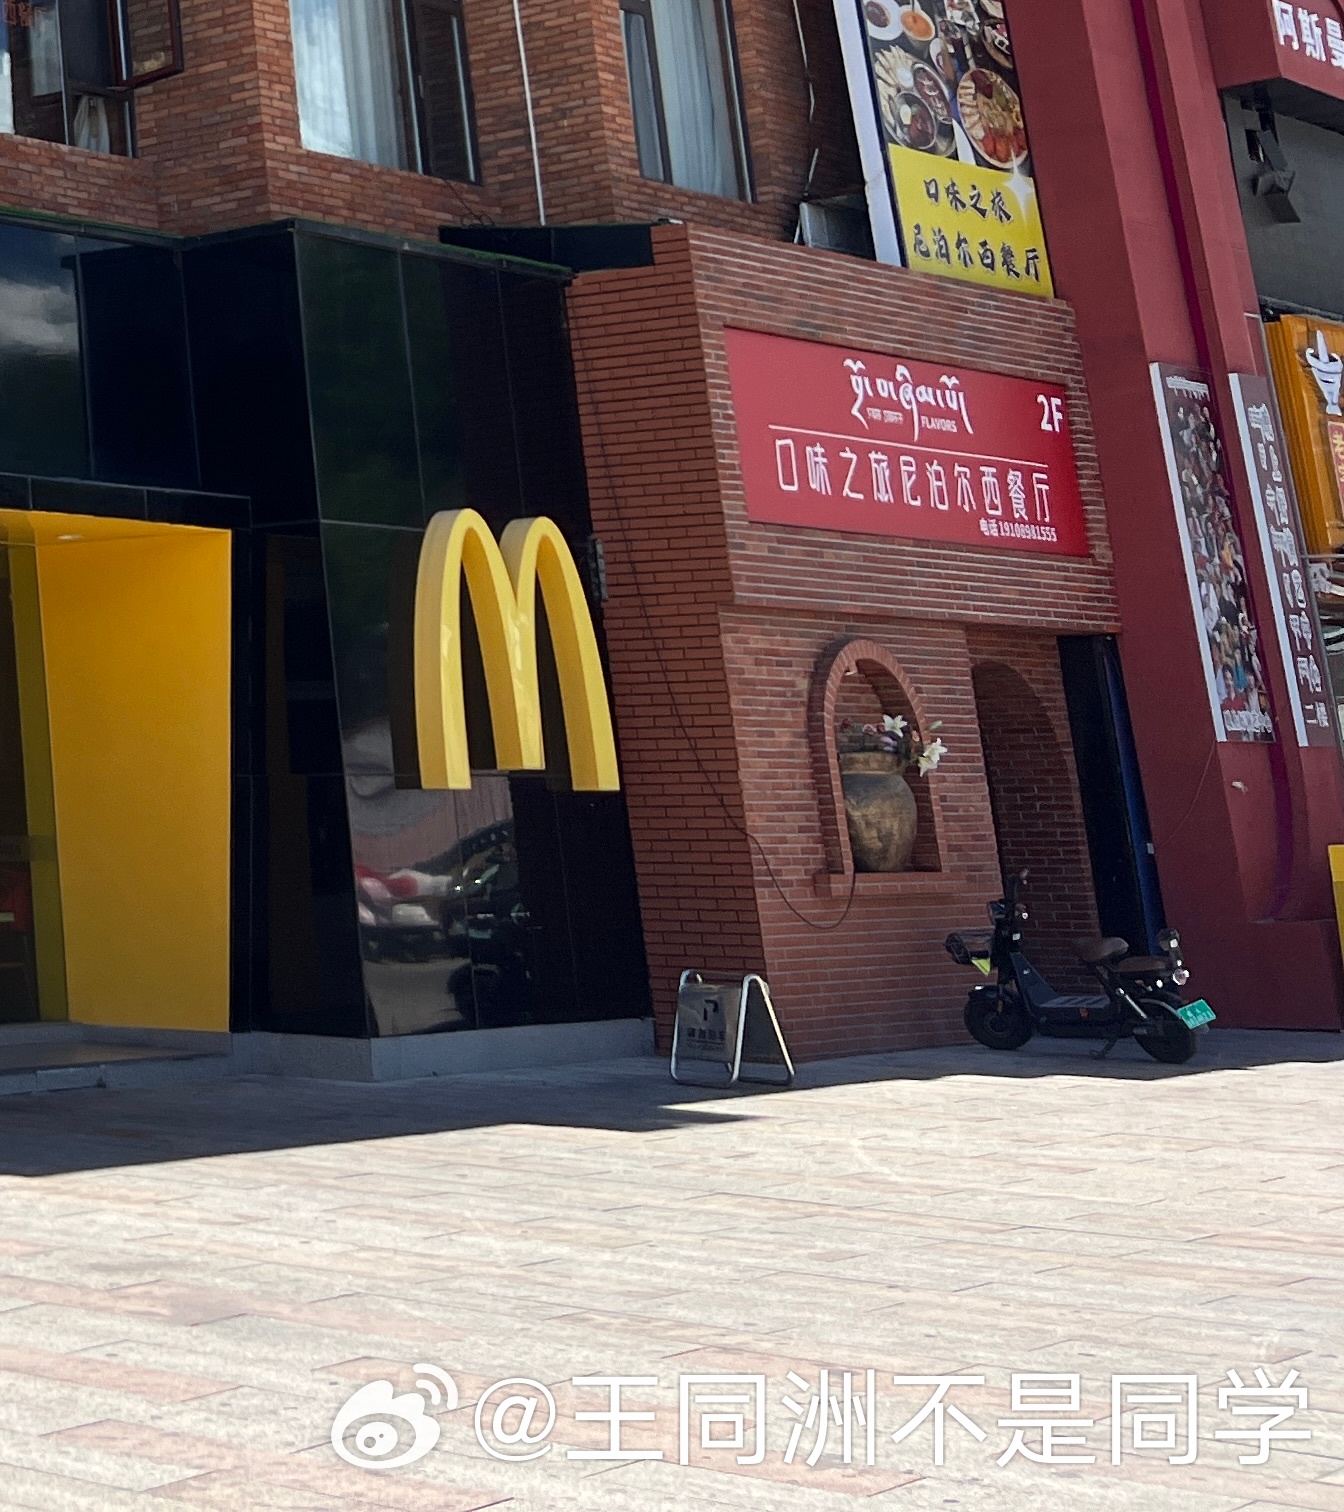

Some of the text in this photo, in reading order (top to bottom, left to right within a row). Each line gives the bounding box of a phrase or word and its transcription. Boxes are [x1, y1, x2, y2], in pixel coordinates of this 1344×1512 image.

[923, 178, 1012, 223] 口味之旅
[913, 223, 1040, 282] 尼泊尔西餐厅
[920, 415, 957, 433] FLAVORS
[1037, 394, 1063, 432] 2F
[775, 438, 1050, 522] 口味之旅尼泊尔西餐厅
